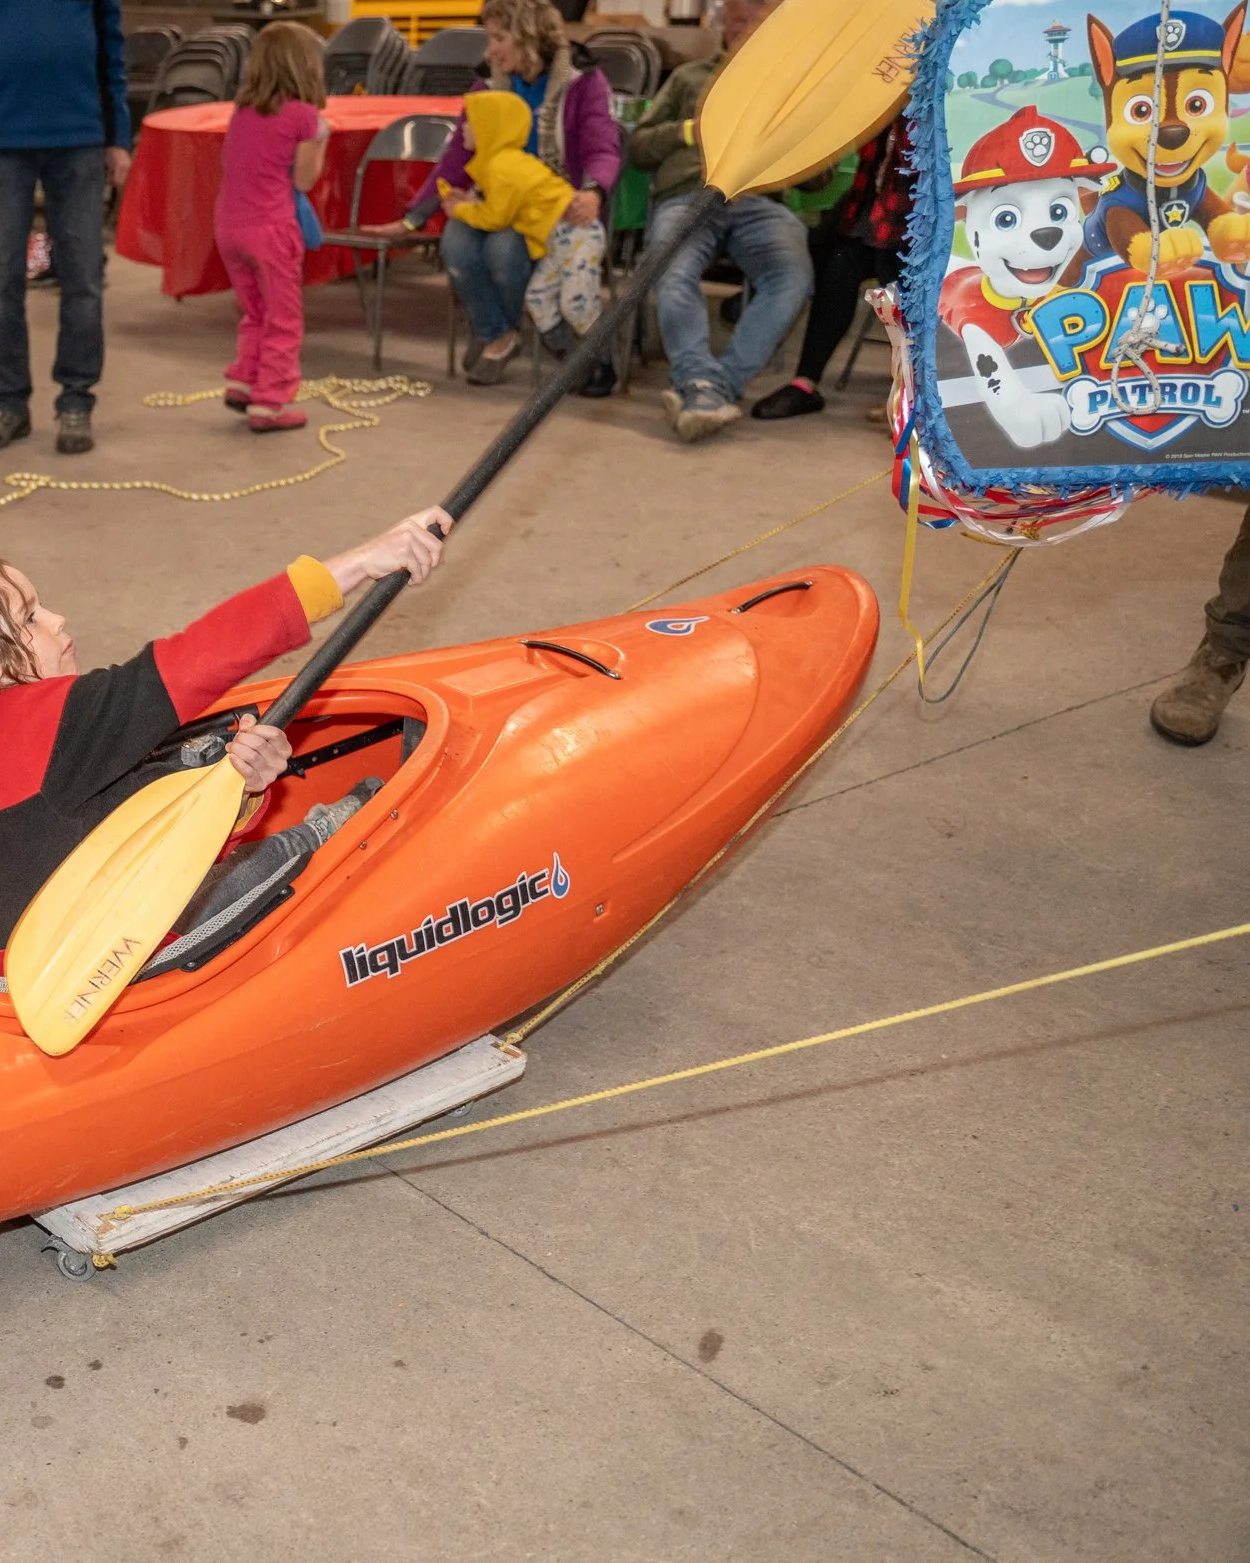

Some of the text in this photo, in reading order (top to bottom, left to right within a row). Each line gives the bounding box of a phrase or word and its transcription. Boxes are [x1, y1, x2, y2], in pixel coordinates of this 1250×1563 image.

[1029, 280, 1250, 381] PAW
[1088, 382, 1222, 414] PATROL
[340, 869, 549, 986] liquidlogic
[65, 937, 142, 1027] WERNER
